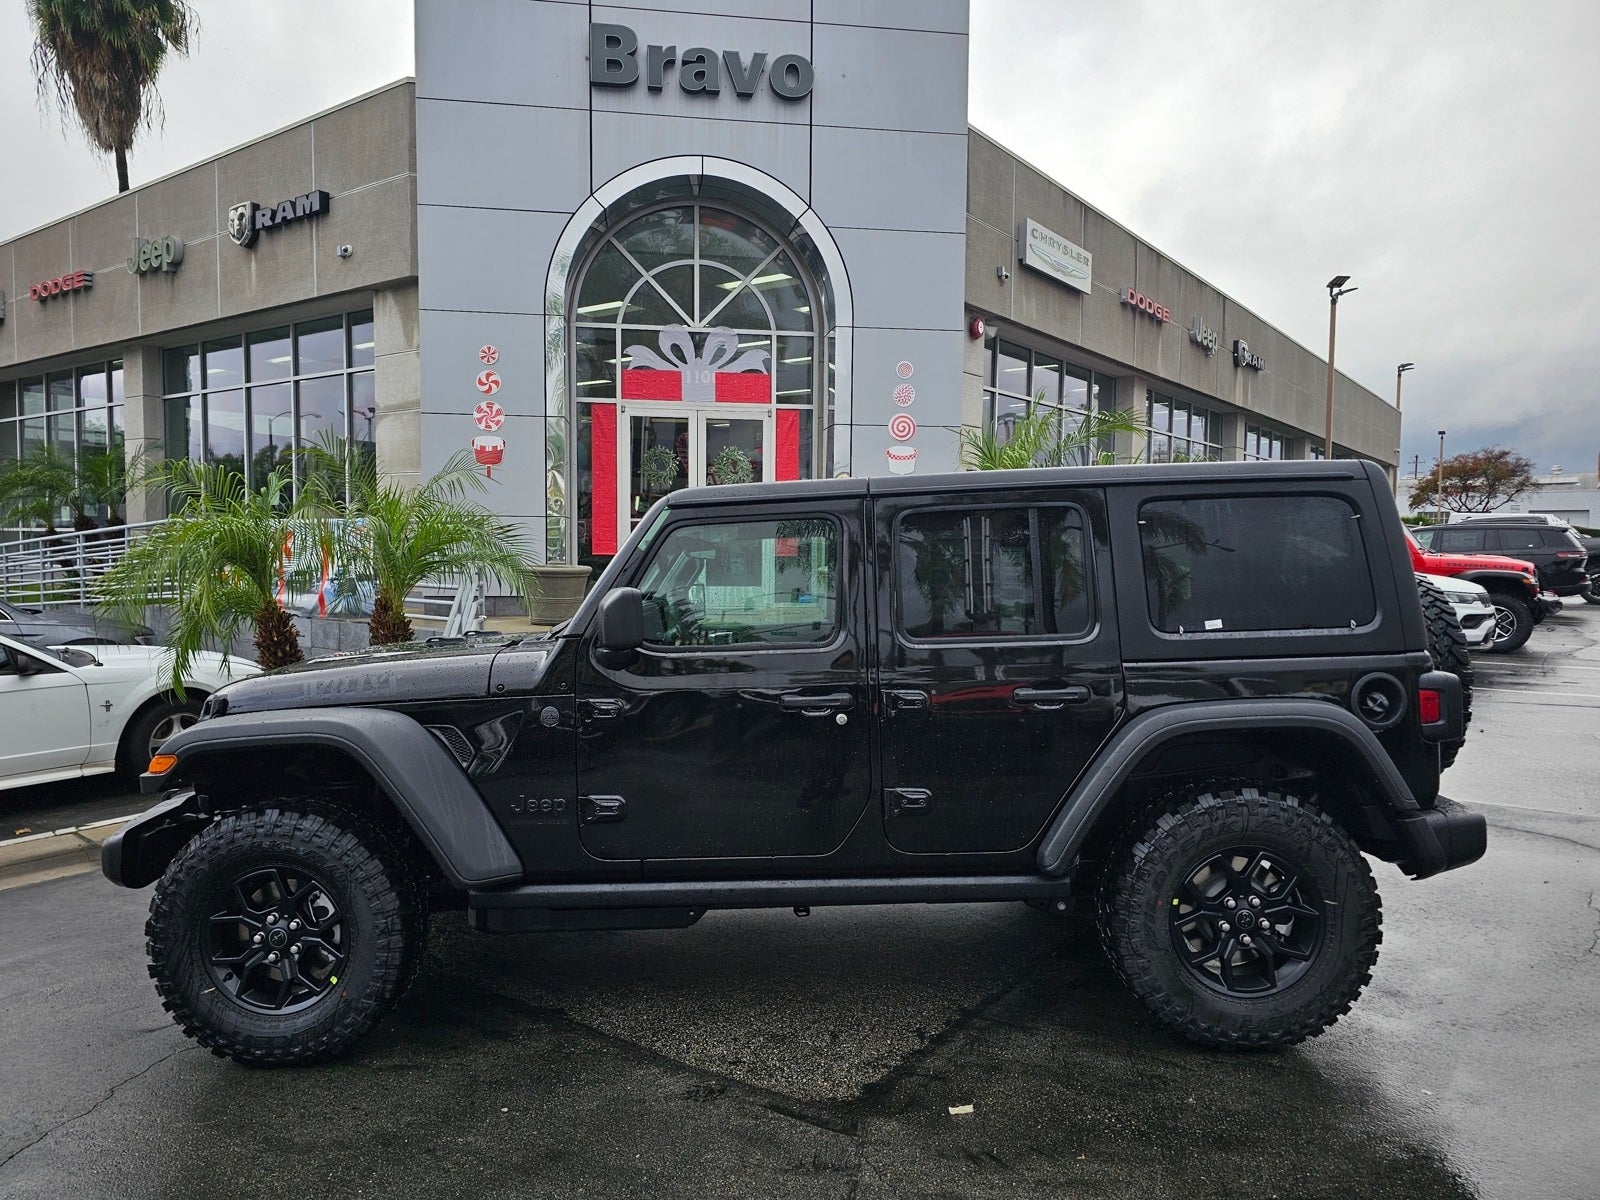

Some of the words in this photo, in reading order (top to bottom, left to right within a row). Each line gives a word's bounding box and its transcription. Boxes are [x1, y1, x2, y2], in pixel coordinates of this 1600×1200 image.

[590, 22, 815, 100] Bravo
[255, 190, 325, 231] RAM
[127, 234, 178, 275] Jeep
[1030, 227, 1090, 266] CHRYSLER
[29, 270, 90, 301] DODGE
[1127, 287, 1171, 323] DODGE
[1195, 316, 1219, 355] Jeep
[1246, 351, 1265, 370] RAM
[1447, 562, 1515, 570] RUBICON
[510, 794, 567, 816] Jeep
